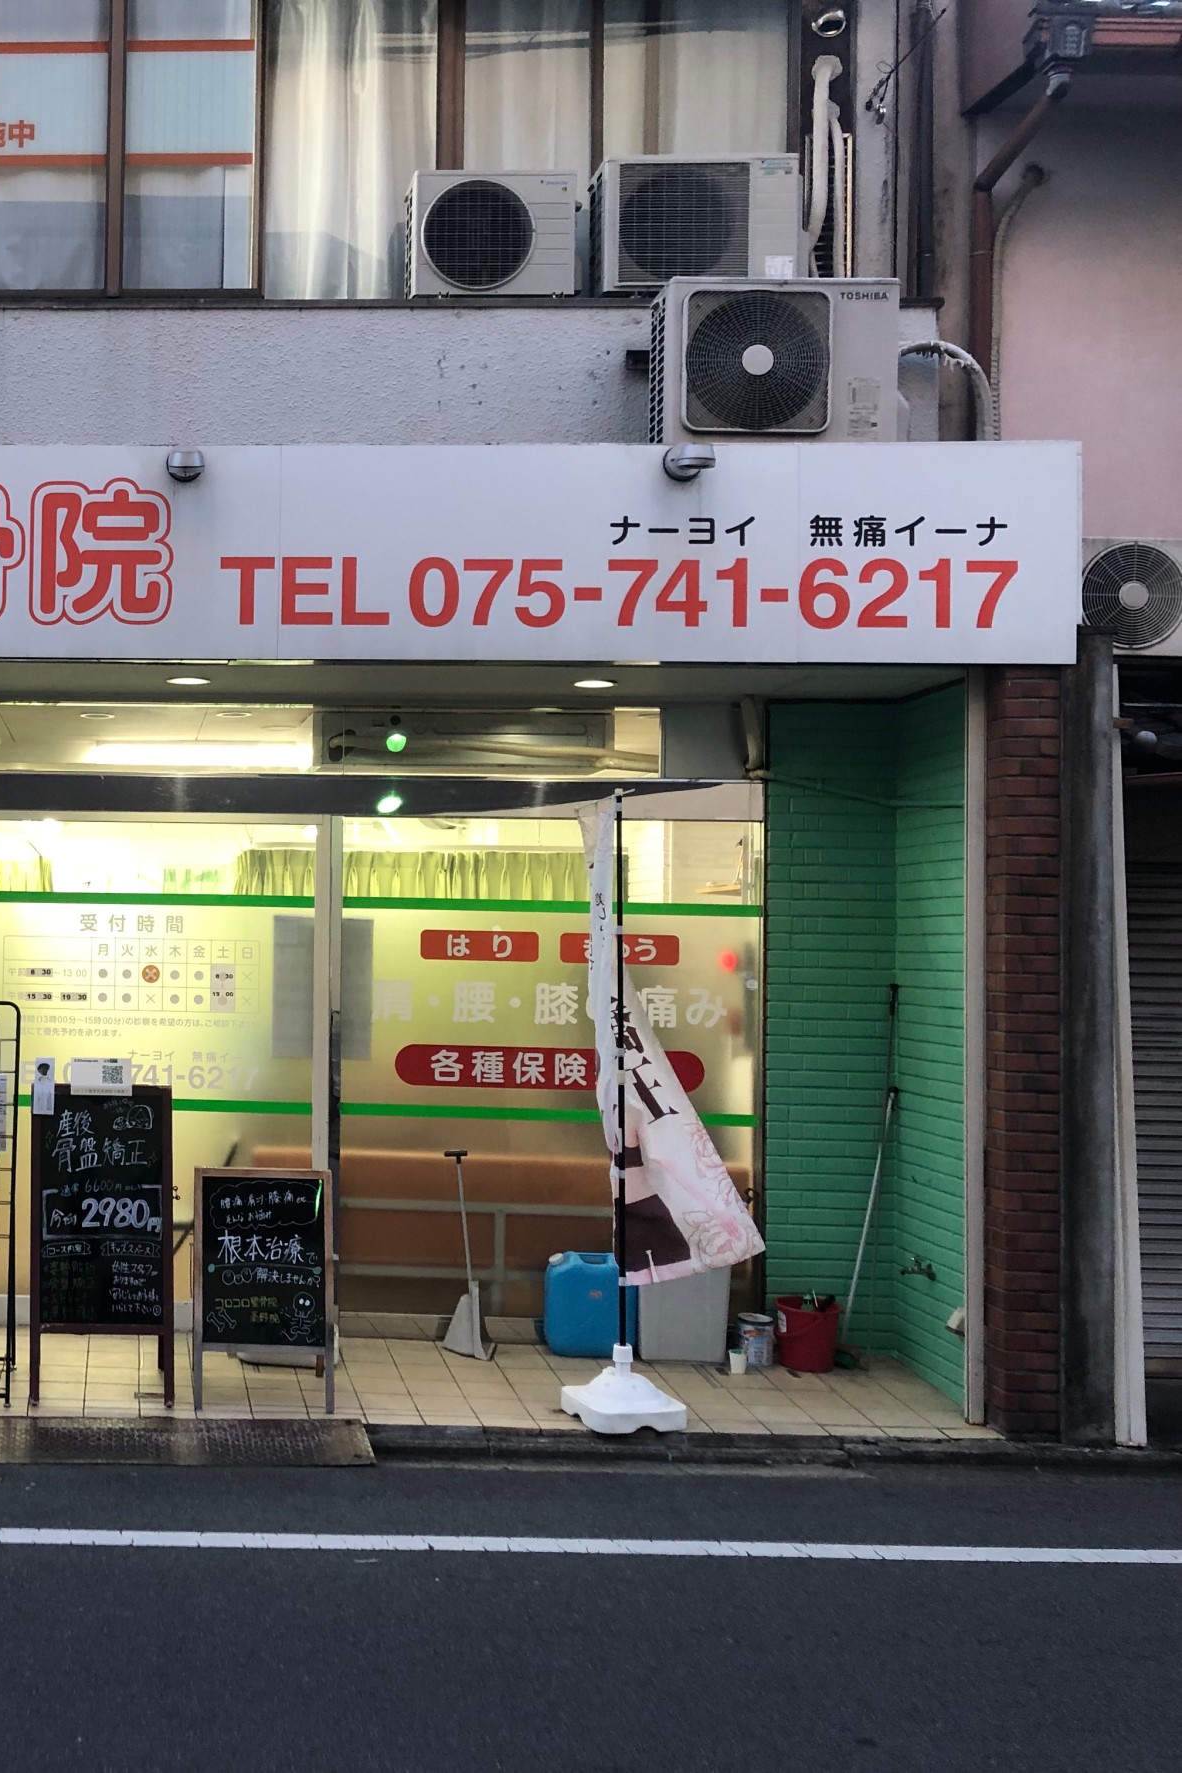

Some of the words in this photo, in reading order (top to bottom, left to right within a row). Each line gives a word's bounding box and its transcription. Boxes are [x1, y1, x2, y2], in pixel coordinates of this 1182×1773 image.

[840, 291, 889, 300] TOSHIBA
[610, 515, 756, 547] ナーヨイ
[809, 515, 1009, 547] 無痛イーナ
[220, 556, 390, 627] TEL
[408, 556, 1018, 630] 075-741-6217
[80, 914, 183, 933] 受付時間
[98, 944, 109, 956] 月
[121, 944, 133, 956] 火
[145, 945, 157, 957] 水
[169, 945, 181, 957] 木
[193, 945, 205, 958] 金
[217, 946, 229, 959] 土
[242, 947, 252, 959] 日
[446, 933, 513, 958] はり
[372, 978, 728, 1029] 肩・腰・膝痛み
[127, 1050, 175, 1061] ナーヨイ
[192, 1052, 242, 1063] 無痛イー
[430, 1049, 597, 1087] 各種保険
[56, 1109, 95, 1138] 産後
[51, 1137, 148, 1173] 骨盤矯正
[81, 1197, 163, 1233] 2980円
